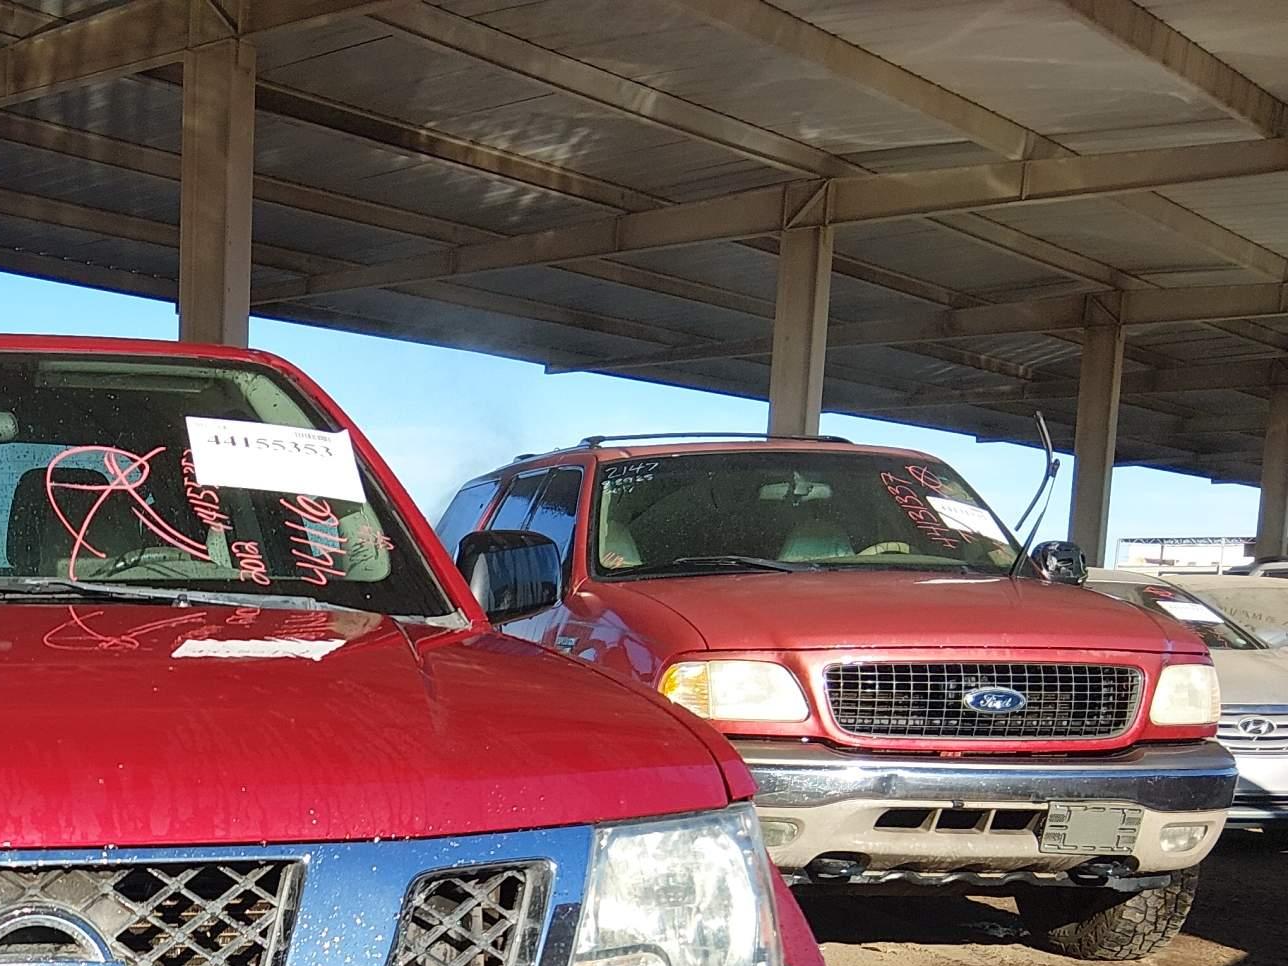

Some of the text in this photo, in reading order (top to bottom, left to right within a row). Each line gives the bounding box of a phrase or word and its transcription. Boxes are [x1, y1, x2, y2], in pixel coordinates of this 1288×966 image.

[207, 432, 334, 458] 44155353
[605, 462, 659, 479] 2147
[230, 540, 272, 586] 2012
[980, 694, 1012, 709] Ford
